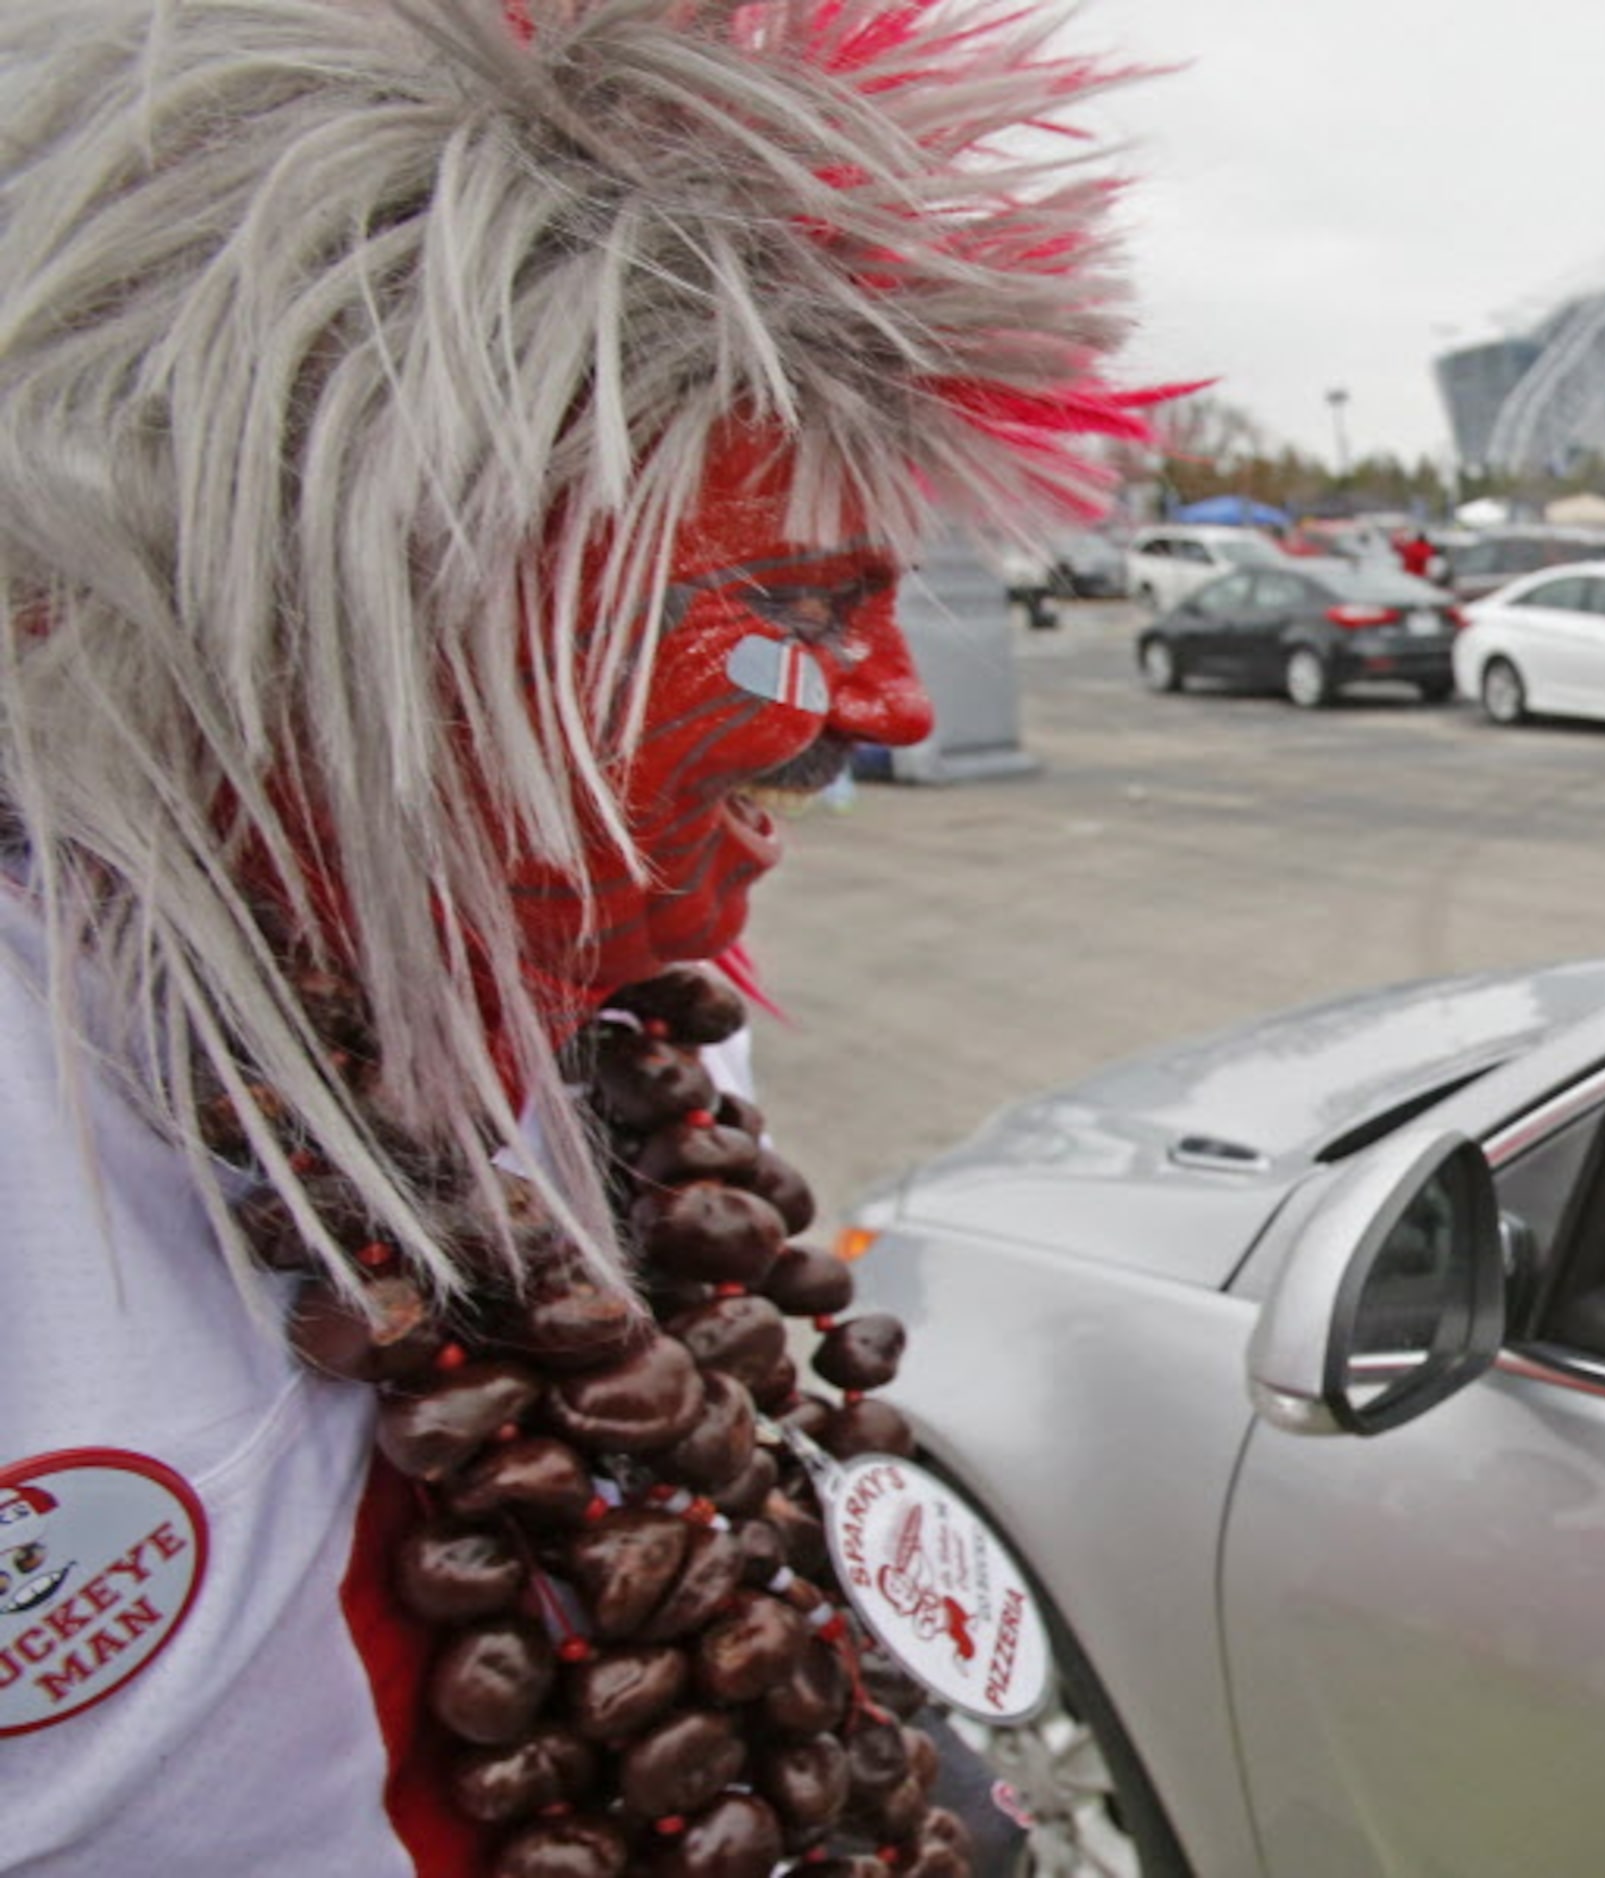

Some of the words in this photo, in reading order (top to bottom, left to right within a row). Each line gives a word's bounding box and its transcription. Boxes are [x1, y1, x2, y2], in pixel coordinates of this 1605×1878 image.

[843, 1465, 906, 1588] SPARKY'S
[35, 1596, 163, 1703] MAN
[985, 1588, 1028, 1710] PIZZERIA
